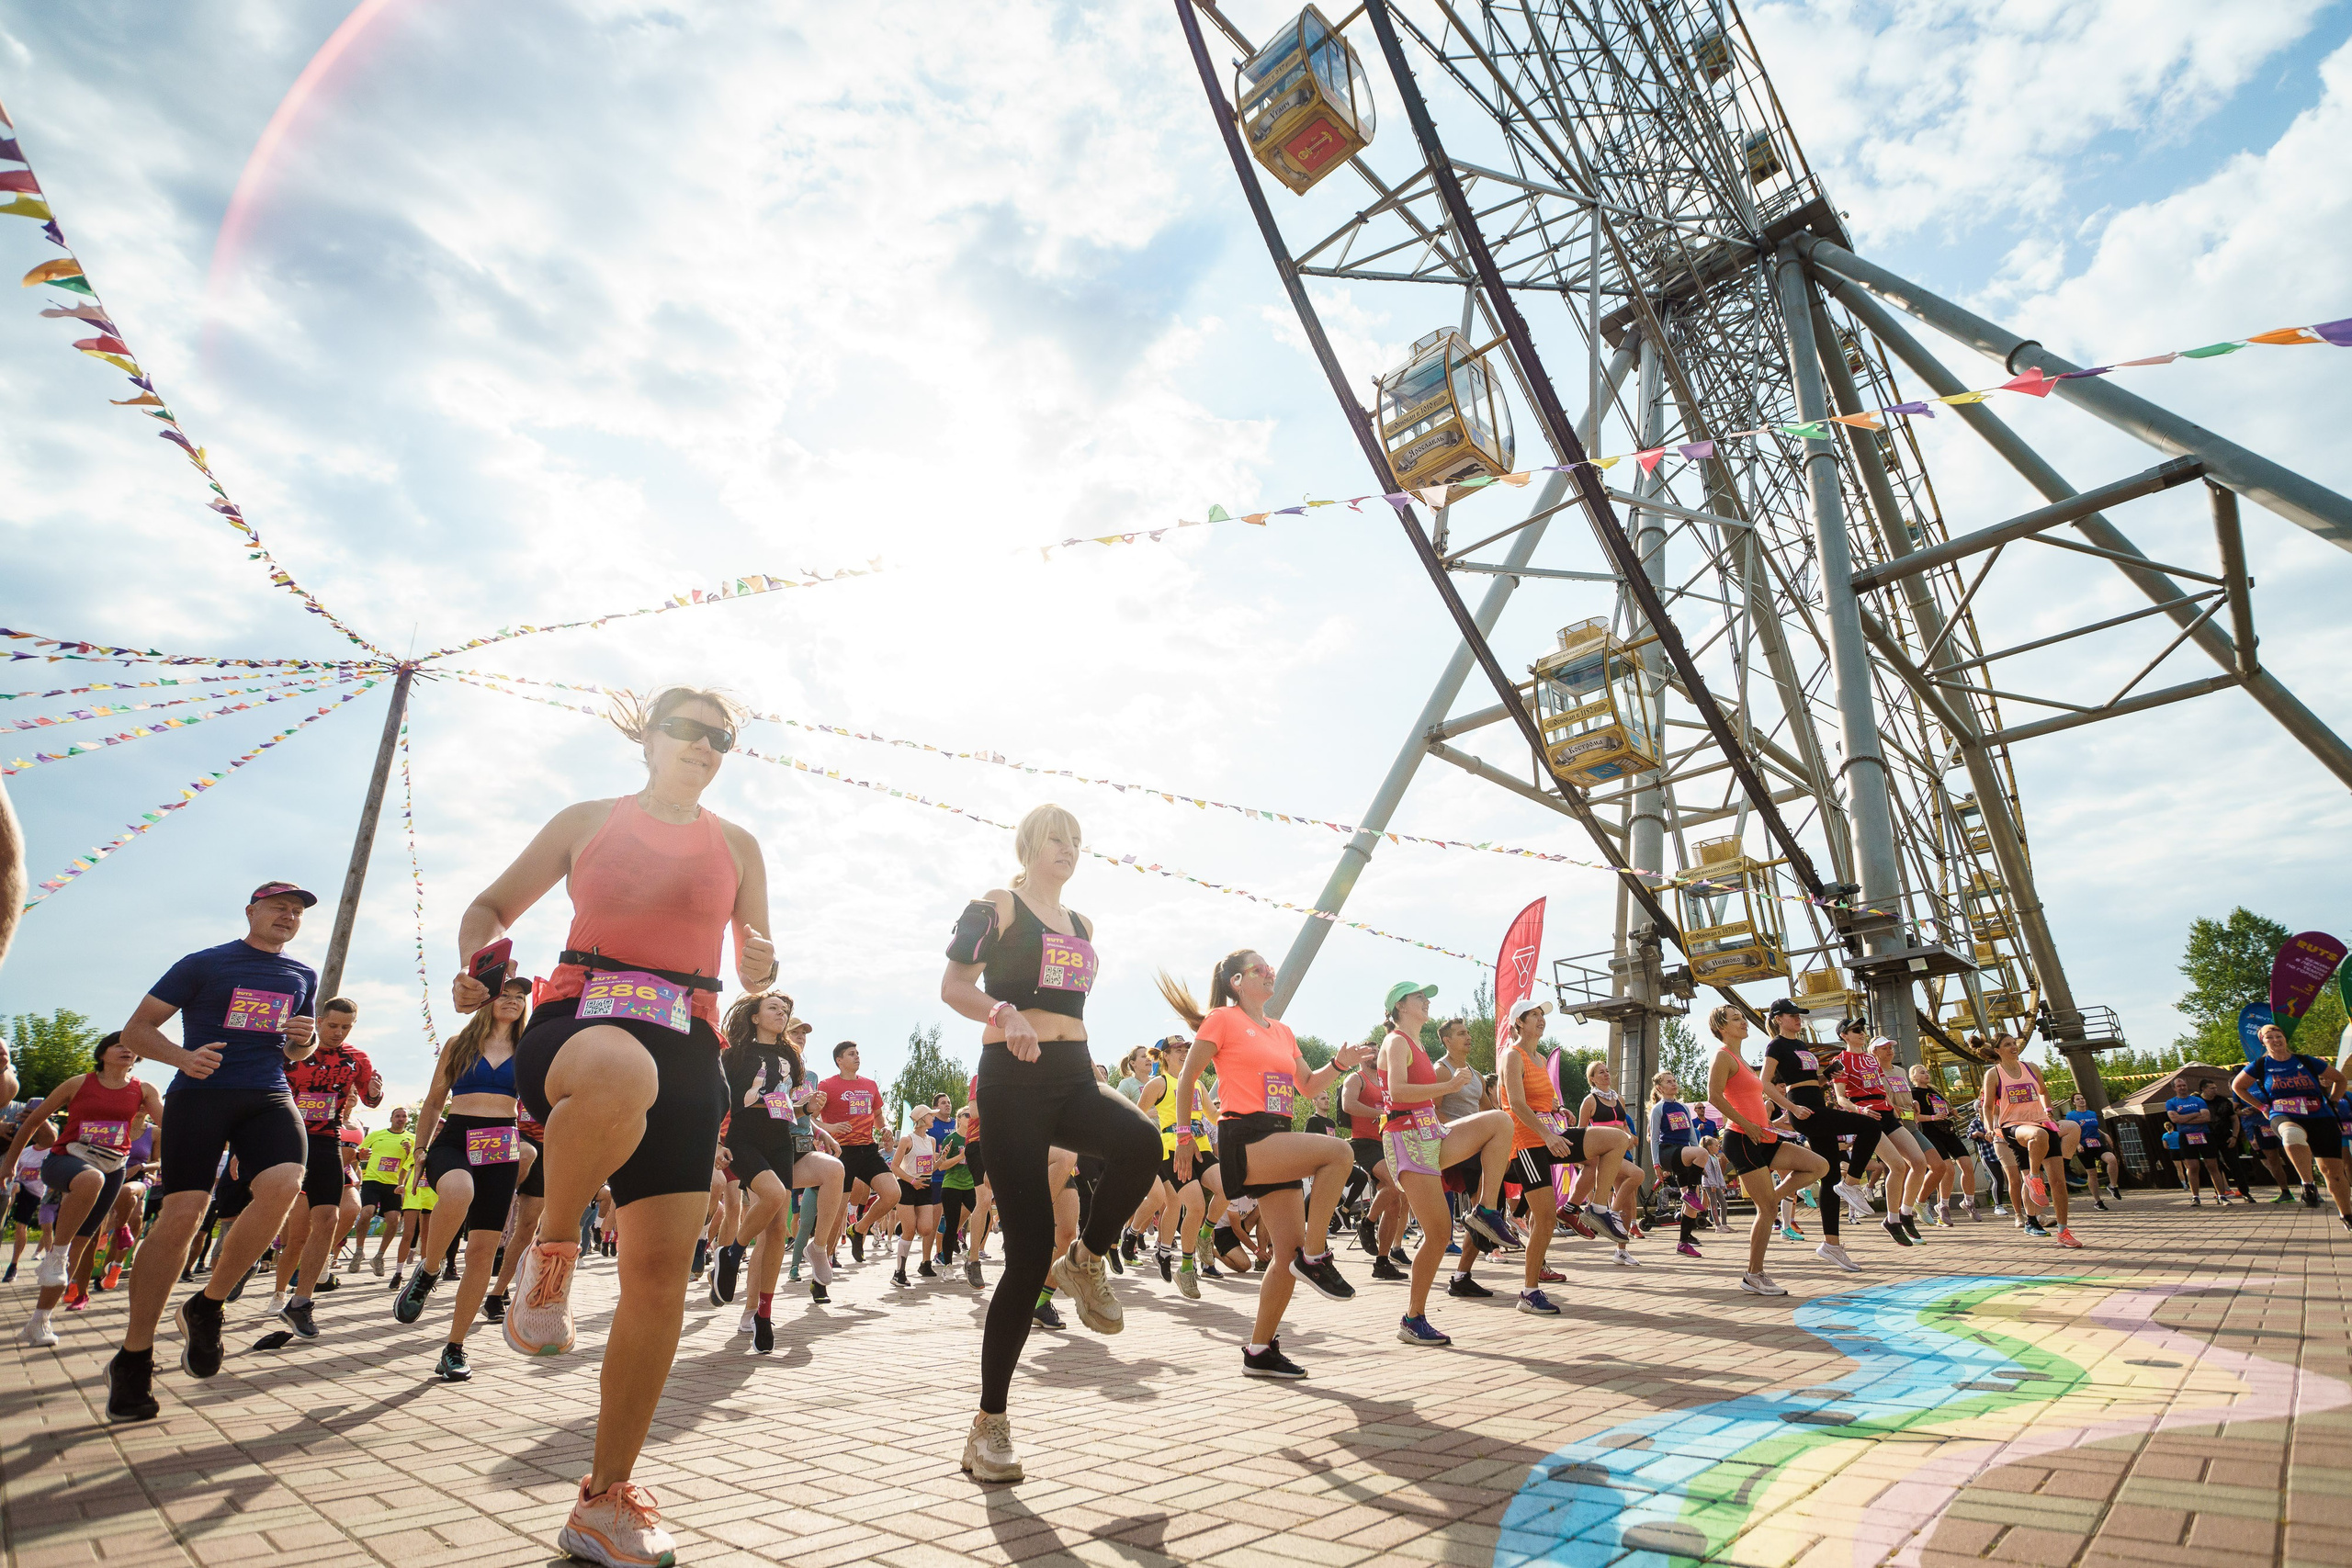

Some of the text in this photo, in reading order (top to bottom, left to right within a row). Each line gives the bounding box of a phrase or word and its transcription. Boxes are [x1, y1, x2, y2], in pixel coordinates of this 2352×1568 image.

[1394, 414, 1416, 428] Основан
[1408, 435, 1445, 458] Ярославль
[1553, 715, 1576, 726] Основан
[1580, 706, 1594, 716] 1152
[1567, 739, 1603, 754] Кострома
[1695, 931, 1717, 939] Основан
[1722, 926, 1735, 934] 1871
[2295, 940, 2339, 962] RUTS
[1046, 948, 1084, 969] 128
[1711, 957, 1741, 966] Иваново
[586, 984, 658, 1001] 286
[231, 999, 272, 1015] 272
[2271, 1077, 2315, 1090] МОСКВА
[1267, 1084, 1293, 1099] 043
[2008, 1089, 2029, 1097] 028
[297, 1100, 326, 1110] 280
[767, 1100, 788, 1110] 192
[1416, 1116, 1438, 1127] 184
[1538, 1116, 1554, 1125] 183
[82, 1126, 109, 1134] 144
[469, 1137, 502, 1151] 273
